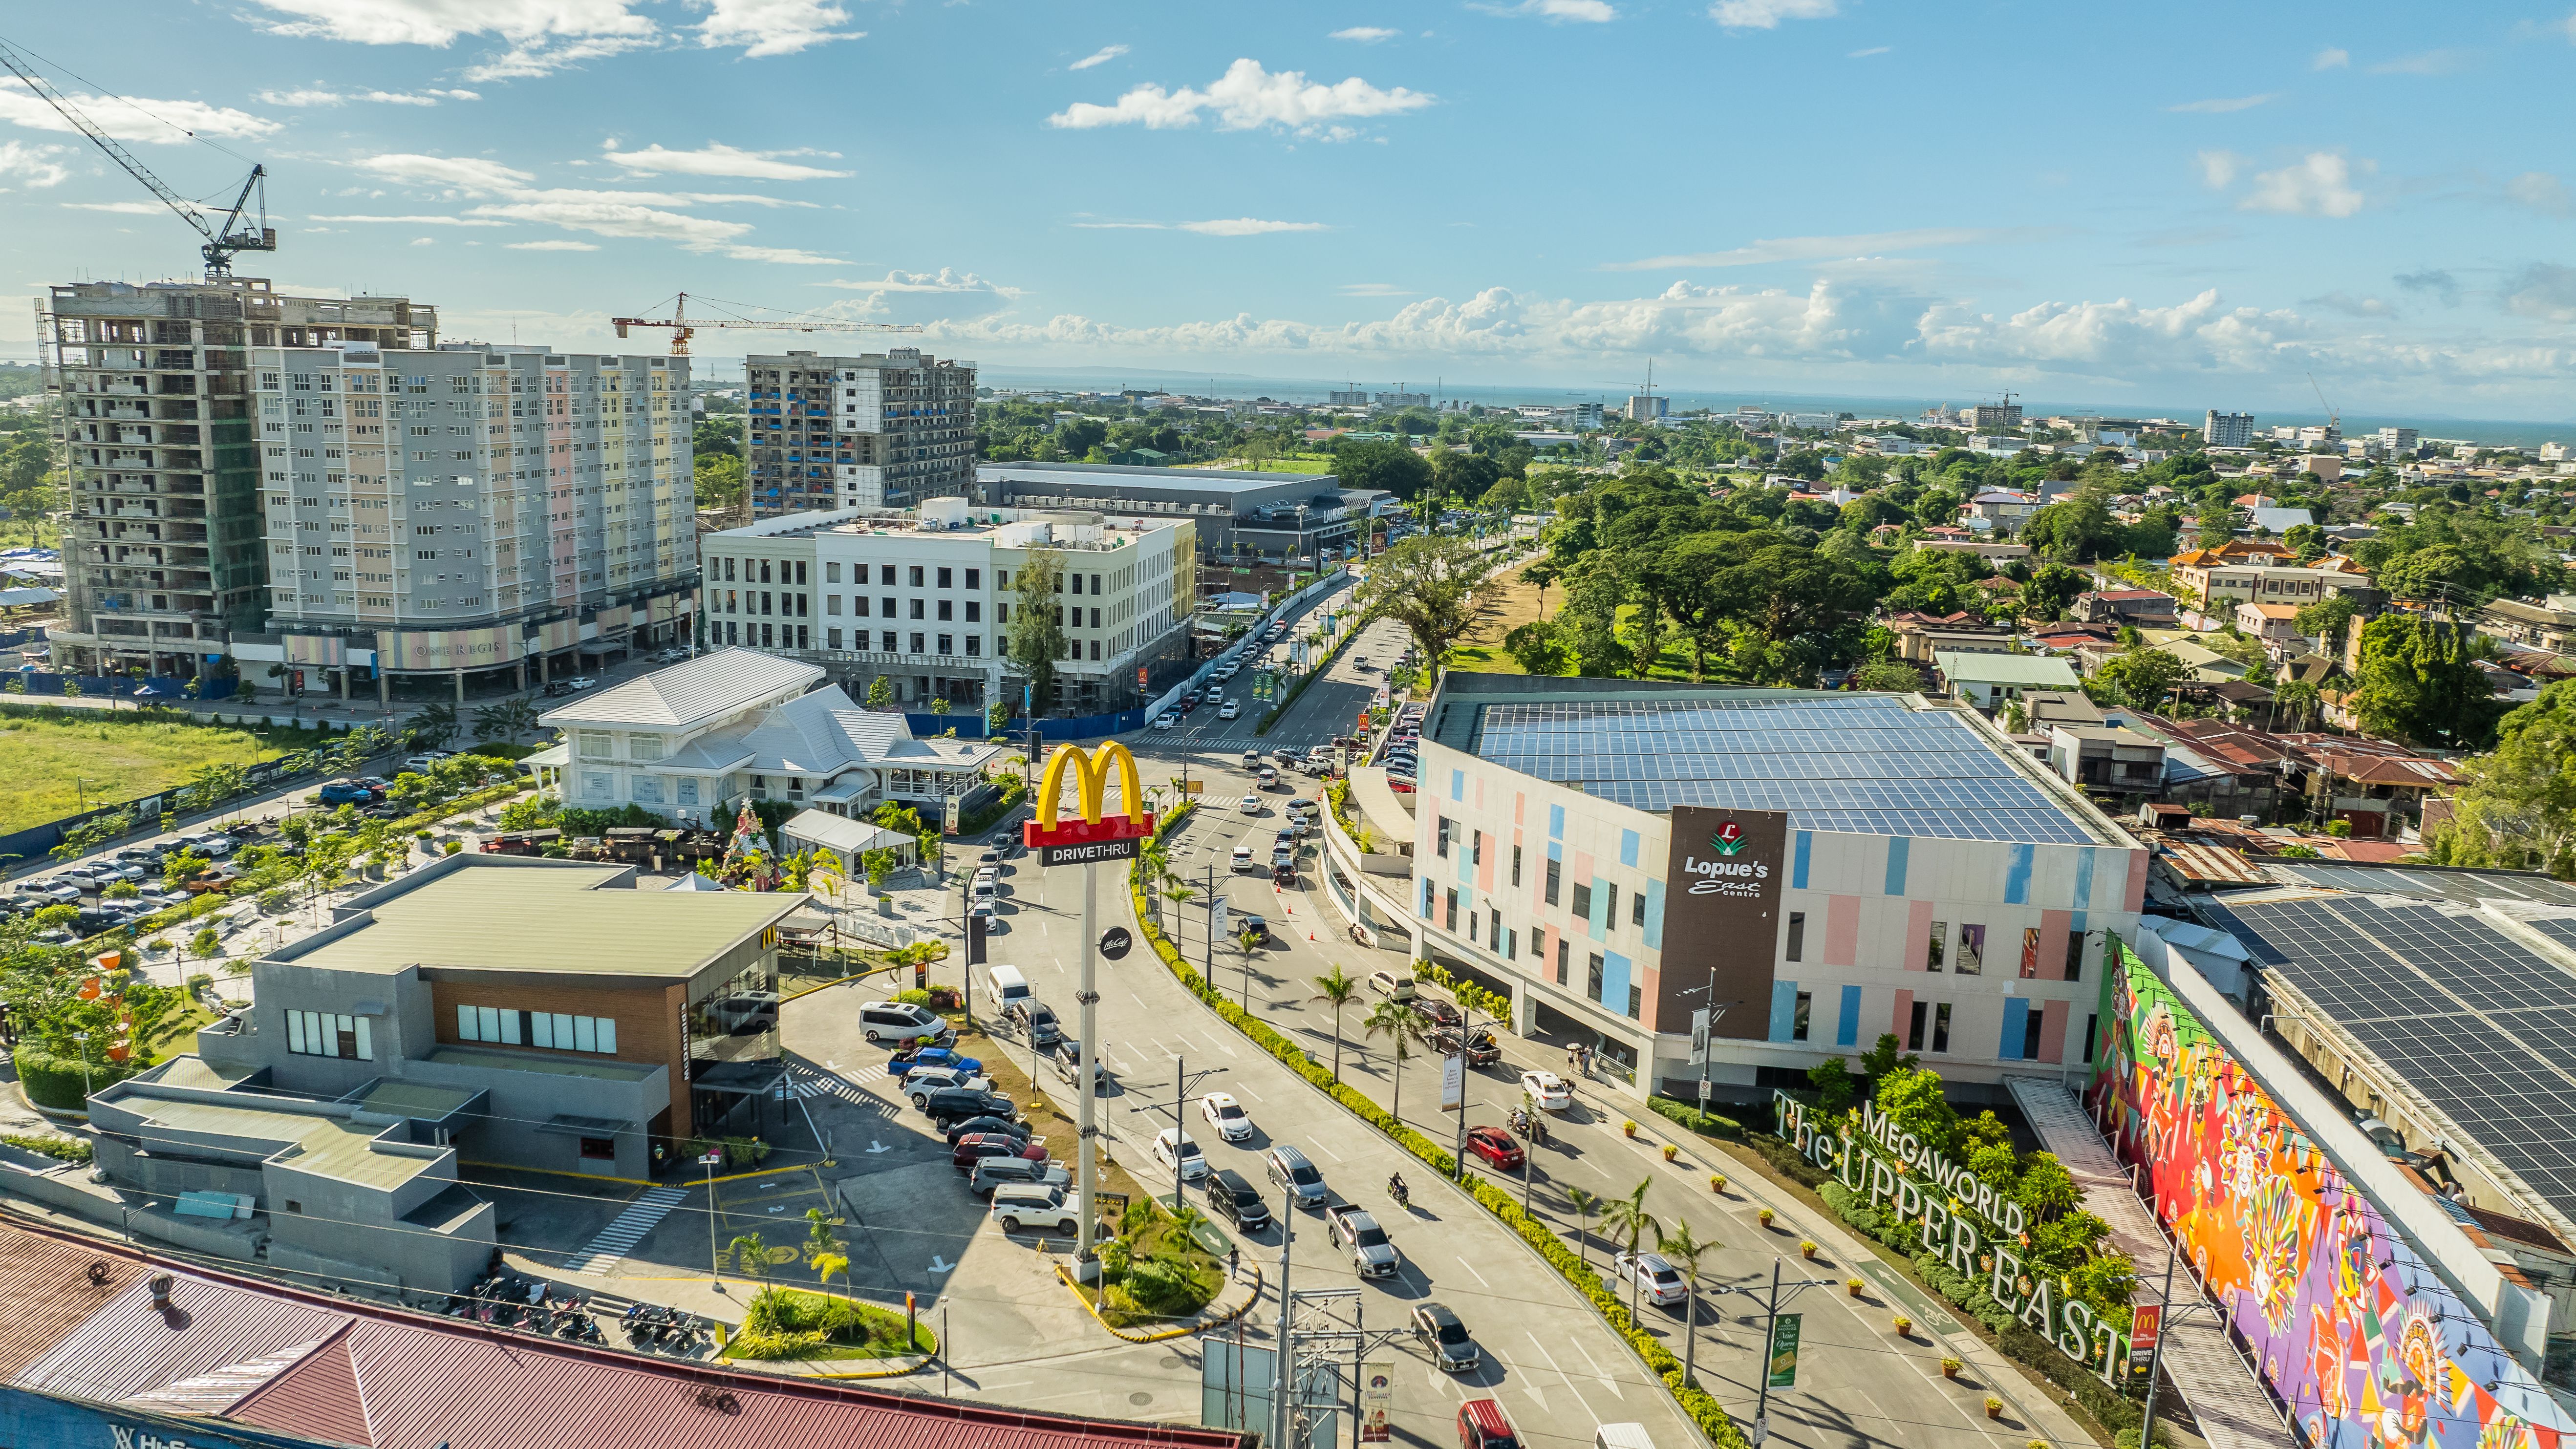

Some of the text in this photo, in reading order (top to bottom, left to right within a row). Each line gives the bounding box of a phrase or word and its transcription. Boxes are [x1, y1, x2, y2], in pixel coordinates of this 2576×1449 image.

[415, 641, 501, 656] ONE REGIS
[1684, 856, 1768, 878] Lopue's
[1688, 880, 1760, 895] East
[1773, 1088, 1836, 1171] The
[1863, 1100, 2026, 1235] MEGAWORLD
[1841, 1133, 2125, 1389] UPPER EAST
